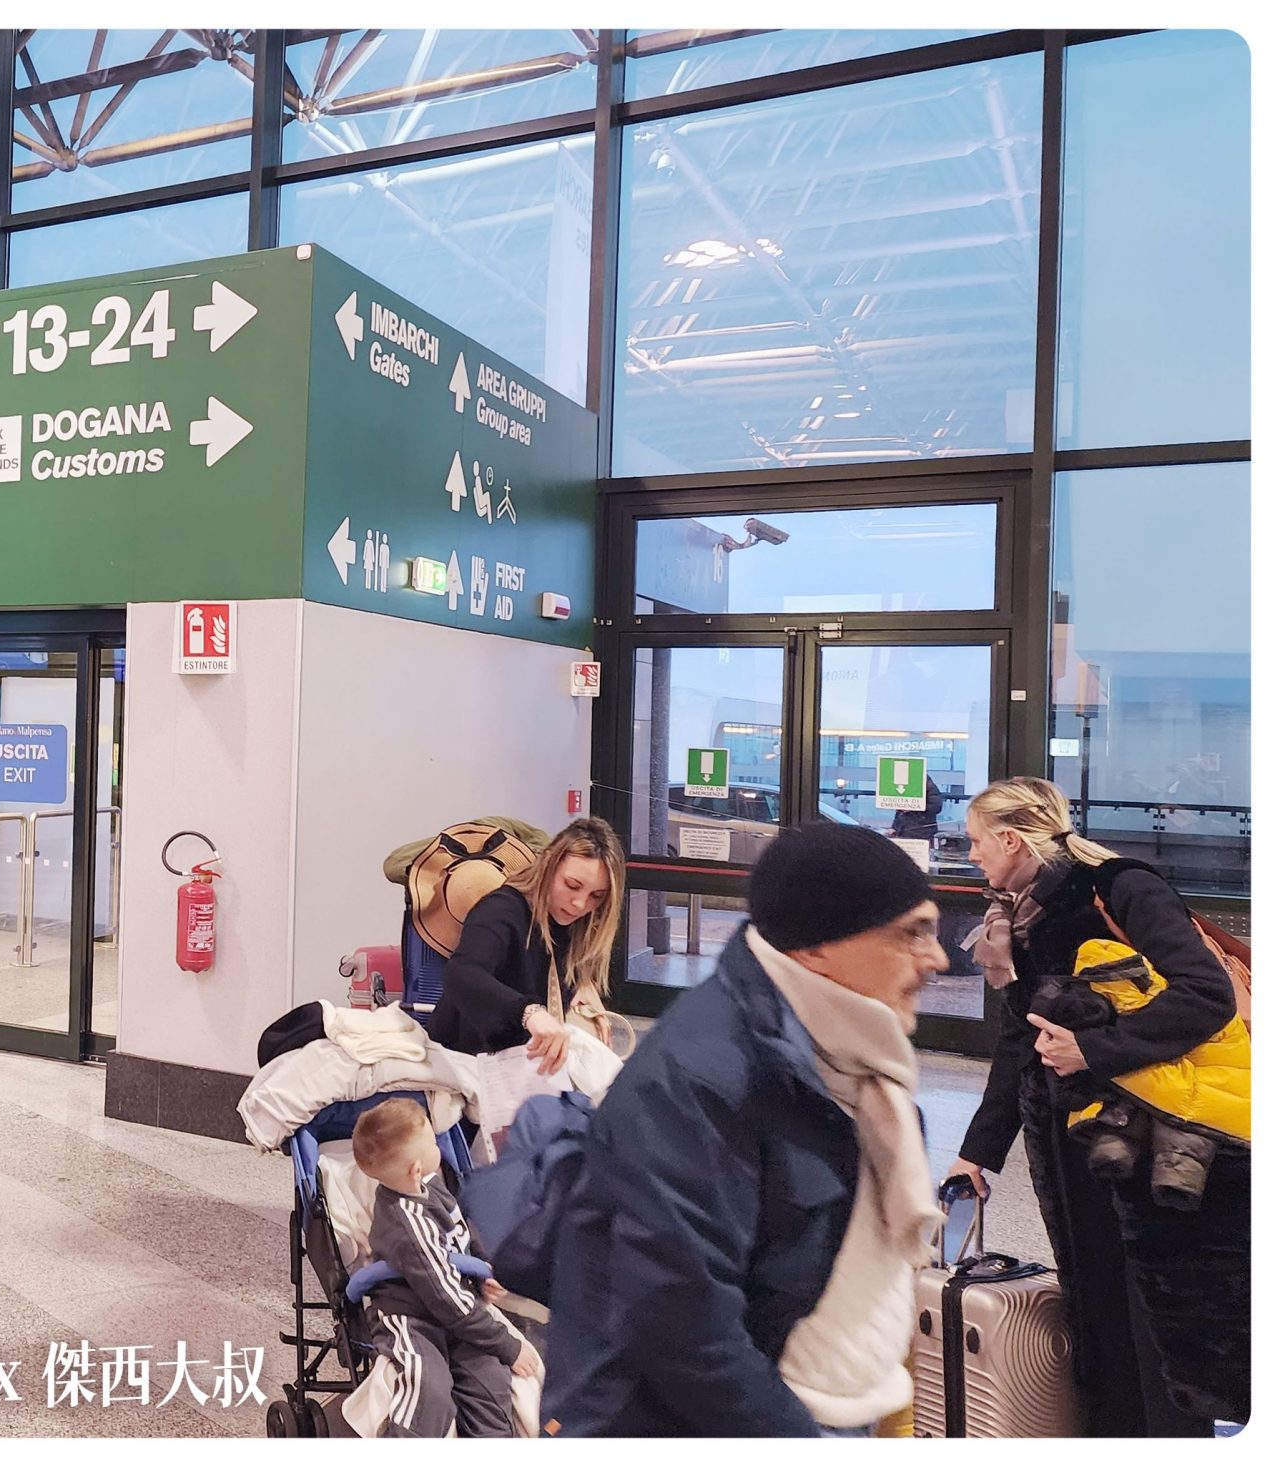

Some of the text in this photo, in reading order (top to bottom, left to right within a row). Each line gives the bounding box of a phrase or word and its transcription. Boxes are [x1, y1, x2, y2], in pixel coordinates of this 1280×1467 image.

[3, 289, 176, 375] 13-24
[371, 301, 439, 365] IMBARCHI
[370, 341, 410, 387] Gates
[477, 363, 546, 423] AREA GRUPPI
[32, 401, 172, 443] DOGANA
[476, 396, 531, 446] Group area
[31, 448, 165, 481] Customs
[495, 562, 526, 592] FIRST
[494, 594, 513, 621] AID
[184, 661, 228, 670] ESTINTORE
[17, 726, 53, 738] Malpensa
[3, 767, 36, 783] EXIT
